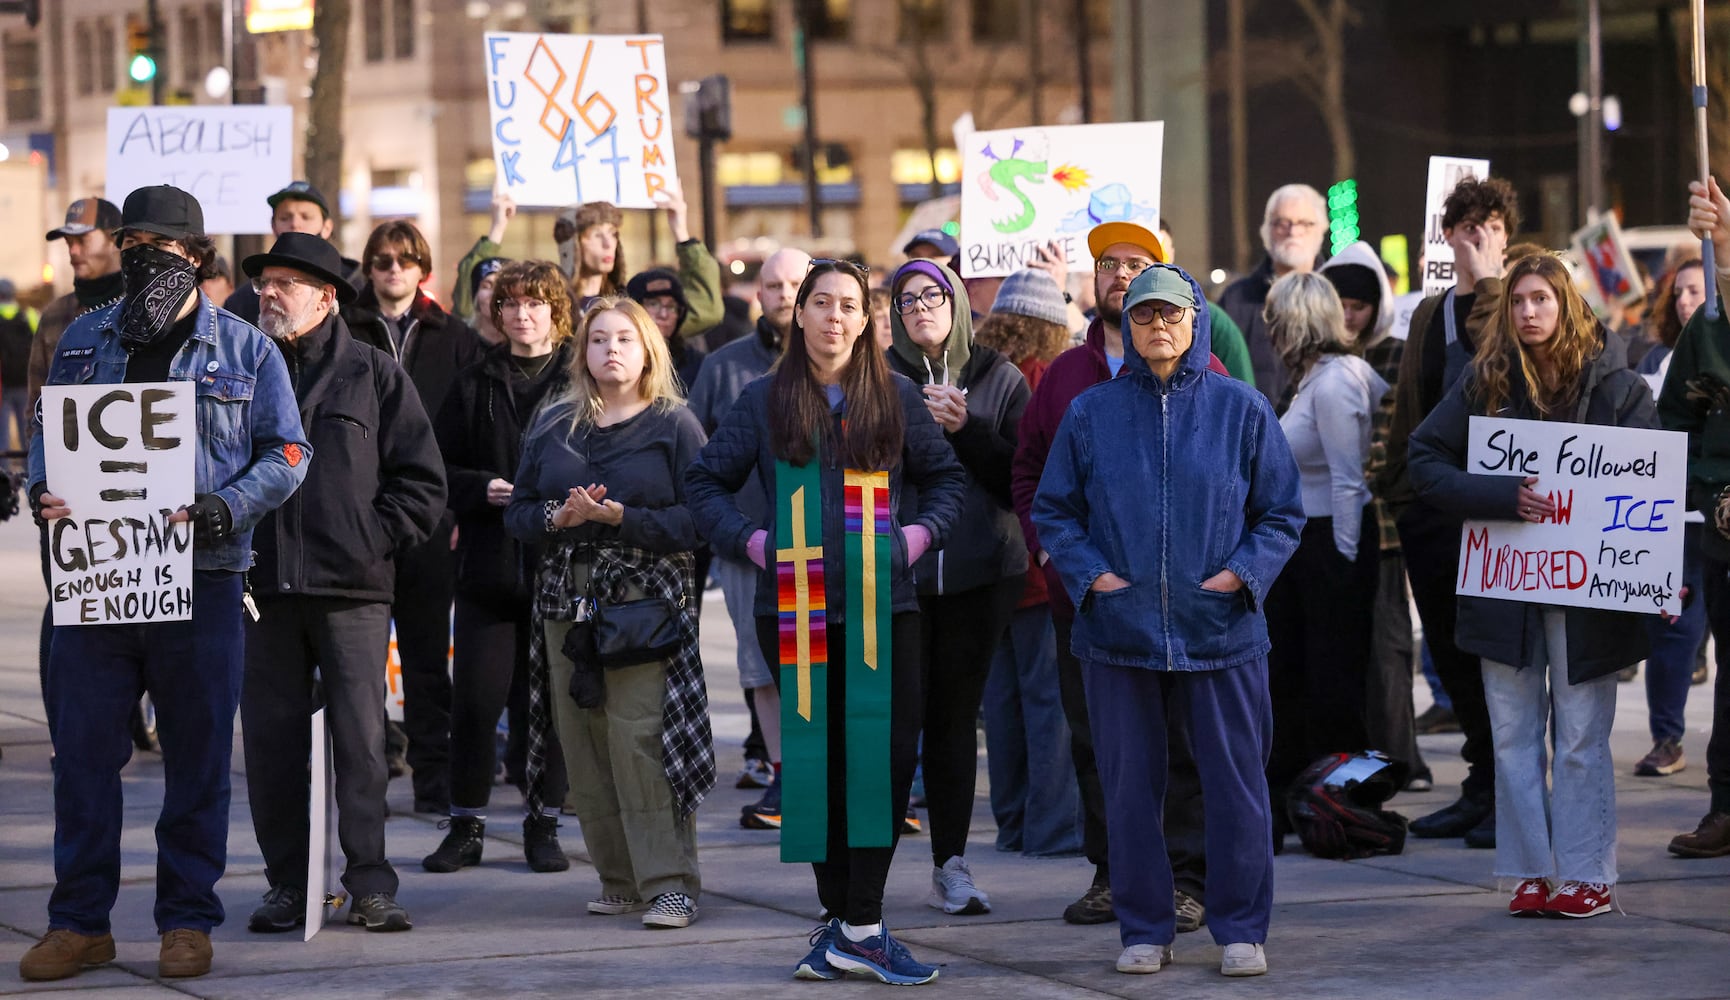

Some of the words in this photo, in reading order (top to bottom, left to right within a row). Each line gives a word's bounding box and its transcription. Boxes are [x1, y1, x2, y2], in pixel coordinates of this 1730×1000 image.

[488, 36, 527, 187] FUCK
[523, 35, 617, 143] 86
[119, 112, 273, 157] ABOLISH
[625, 39, 667, 199] TRUMP
[552, 118, 630, 203] 47
[63, 388, 181, 452] ICE
[1479, 429, 1540, 475] She
[1556, 434, 1657, 479] Followed
[1539, 489, 1573, 526] AW
[1602, 495, 1675, 532] ICE
[54, 568, 142, 602] ENOUGH
[155, 564, 173, 586] IS
[1461, 526, 1588, 593] MURDERED
[1598, 539, 1650, 568] her
[80, 587, 192, 623] ENOUGH
[1588, 572, 1673, 607] Anyway!
